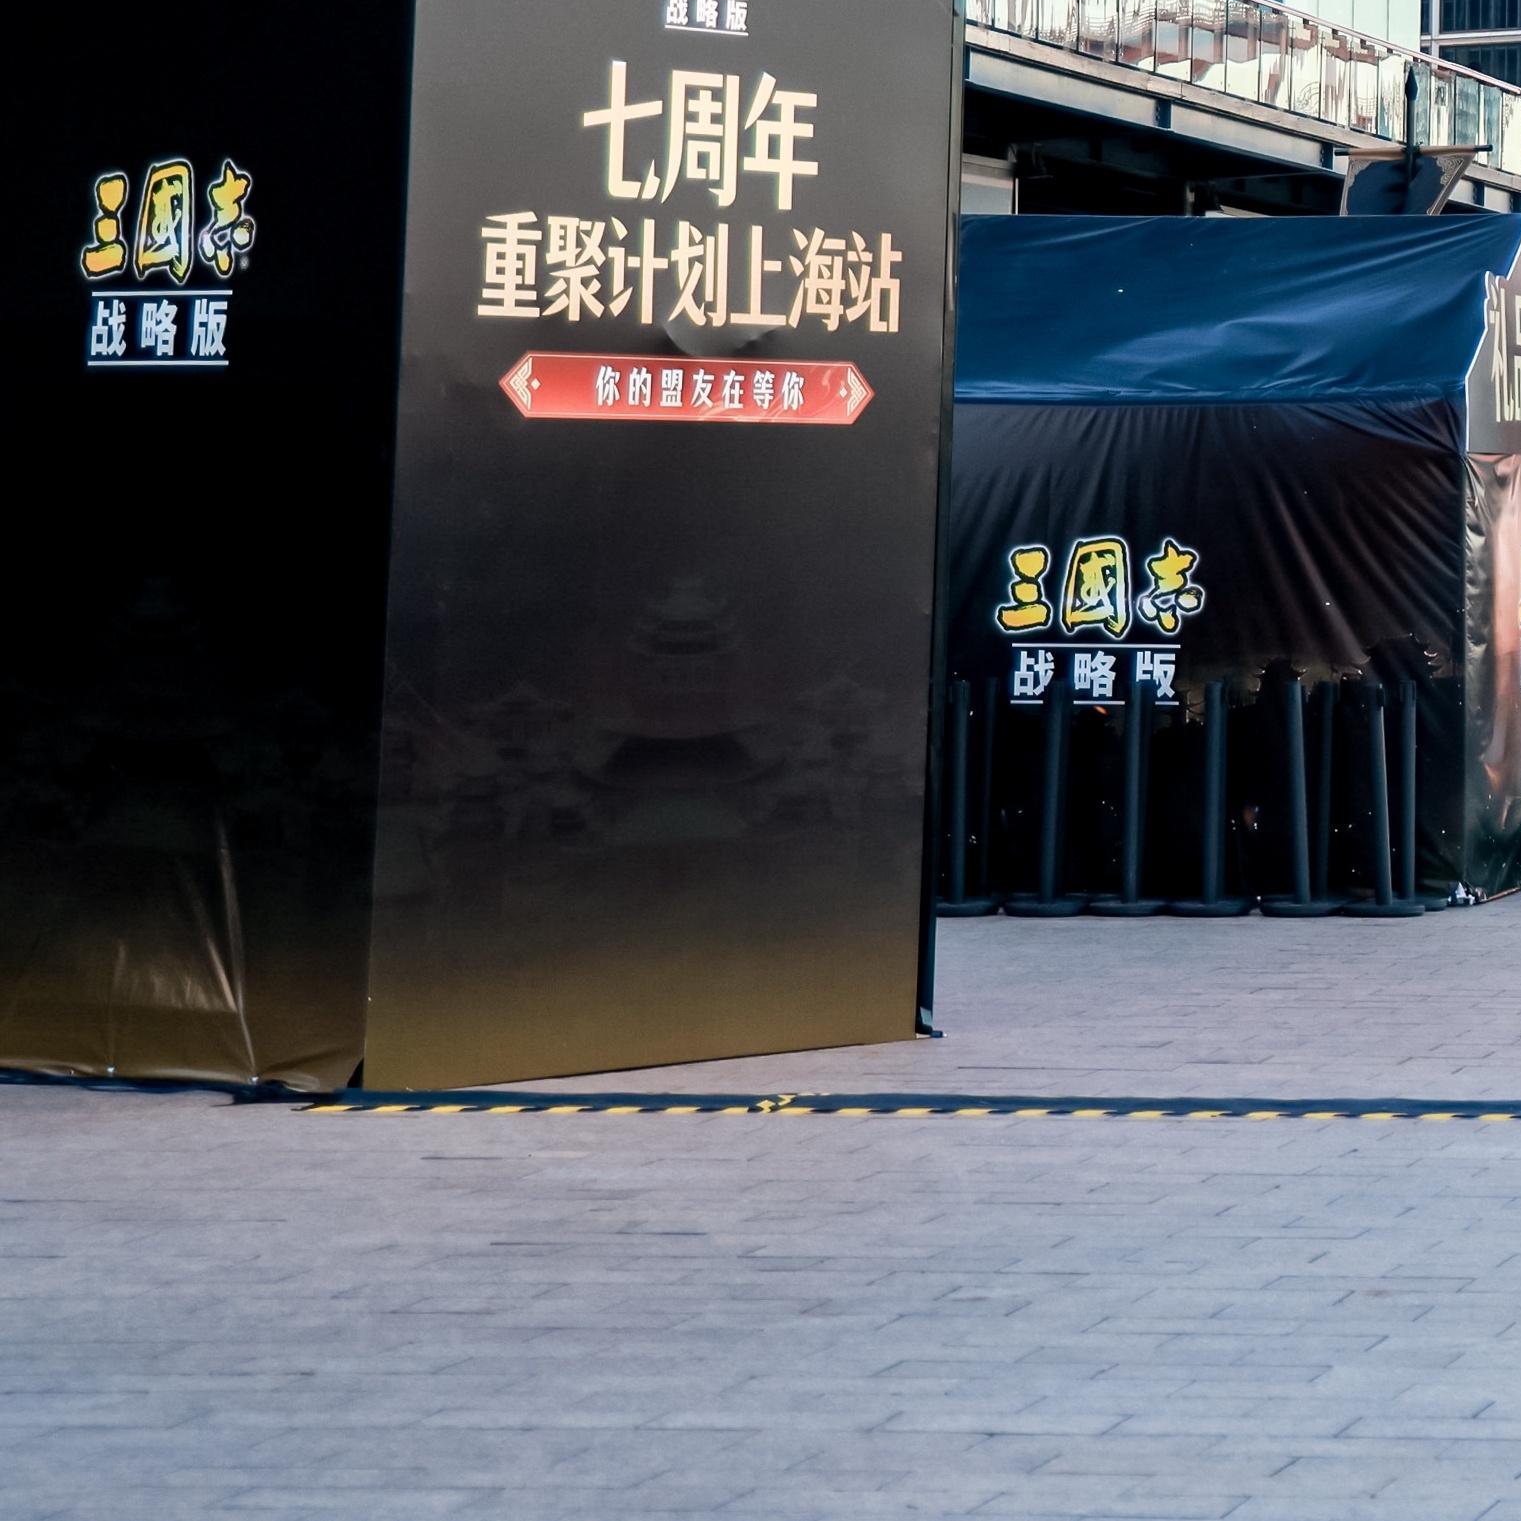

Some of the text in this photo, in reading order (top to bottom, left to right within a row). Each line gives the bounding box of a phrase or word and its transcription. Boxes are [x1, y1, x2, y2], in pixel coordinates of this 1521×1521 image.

[583, 61, 818, 210] 七周年
[80, 158, 255, 284] 三國志
[477, 211, 903, 333] 重聚计划上海站
[90, 298, 229, 357] 战略版
[595, 365, 806, 411] 你的盟友在等你
[994, 537, 1207, 638] 三國志
[1012, 649, 1178, 699] 战略版
